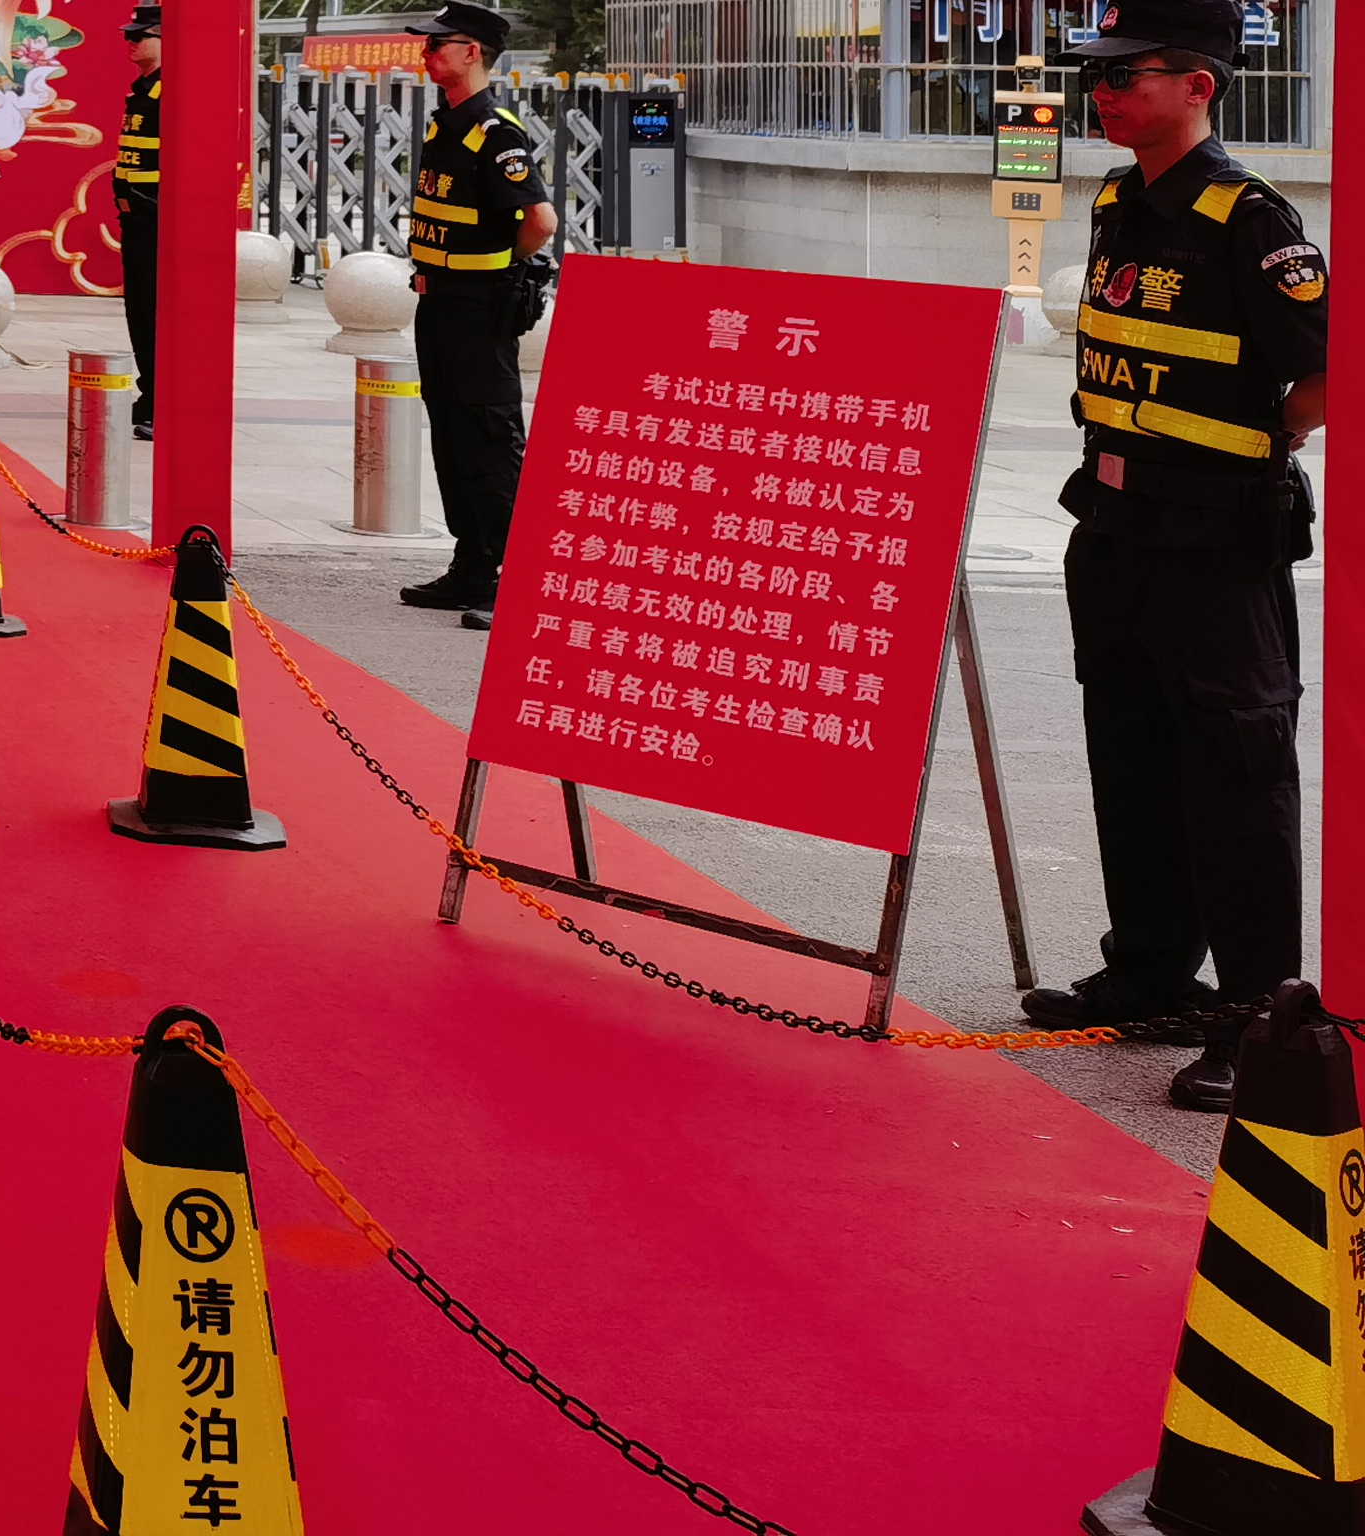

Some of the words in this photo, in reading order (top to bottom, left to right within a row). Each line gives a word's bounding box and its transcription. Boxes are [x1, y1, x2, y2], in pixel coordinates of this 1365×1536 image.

[410, 218, 448, 244] SWAT
[1265, 245, 1308, 265] SWAT
[1090, 255, 1184, 312] 特警
[707, 308, 821, 357] 警示
[642, 372, 931, 433] 考试过程中携带手机
[1080, 348, 1170, 396] SWAT
[573, 404, 923, 476] 等具有发送或者接收信息
[565, 448, 915, 522] 功能的设备，将被认定为
[557, 488, 908, 567] 考试作弊，按规定给予报
[549, 530, 900, 613] 名参加考试的各阶段、各
[540, 571, 894, 657] 科成绩无效的处理，情节
[533, 613, 885, 705] 严重者将被追究刑事责
[515, 699, 714, 766] 后再进行安检。
[525, 655, 876, 752] 任，请各位考生检查确认
[172, 1277, 243, 1529] 请勿泊车
